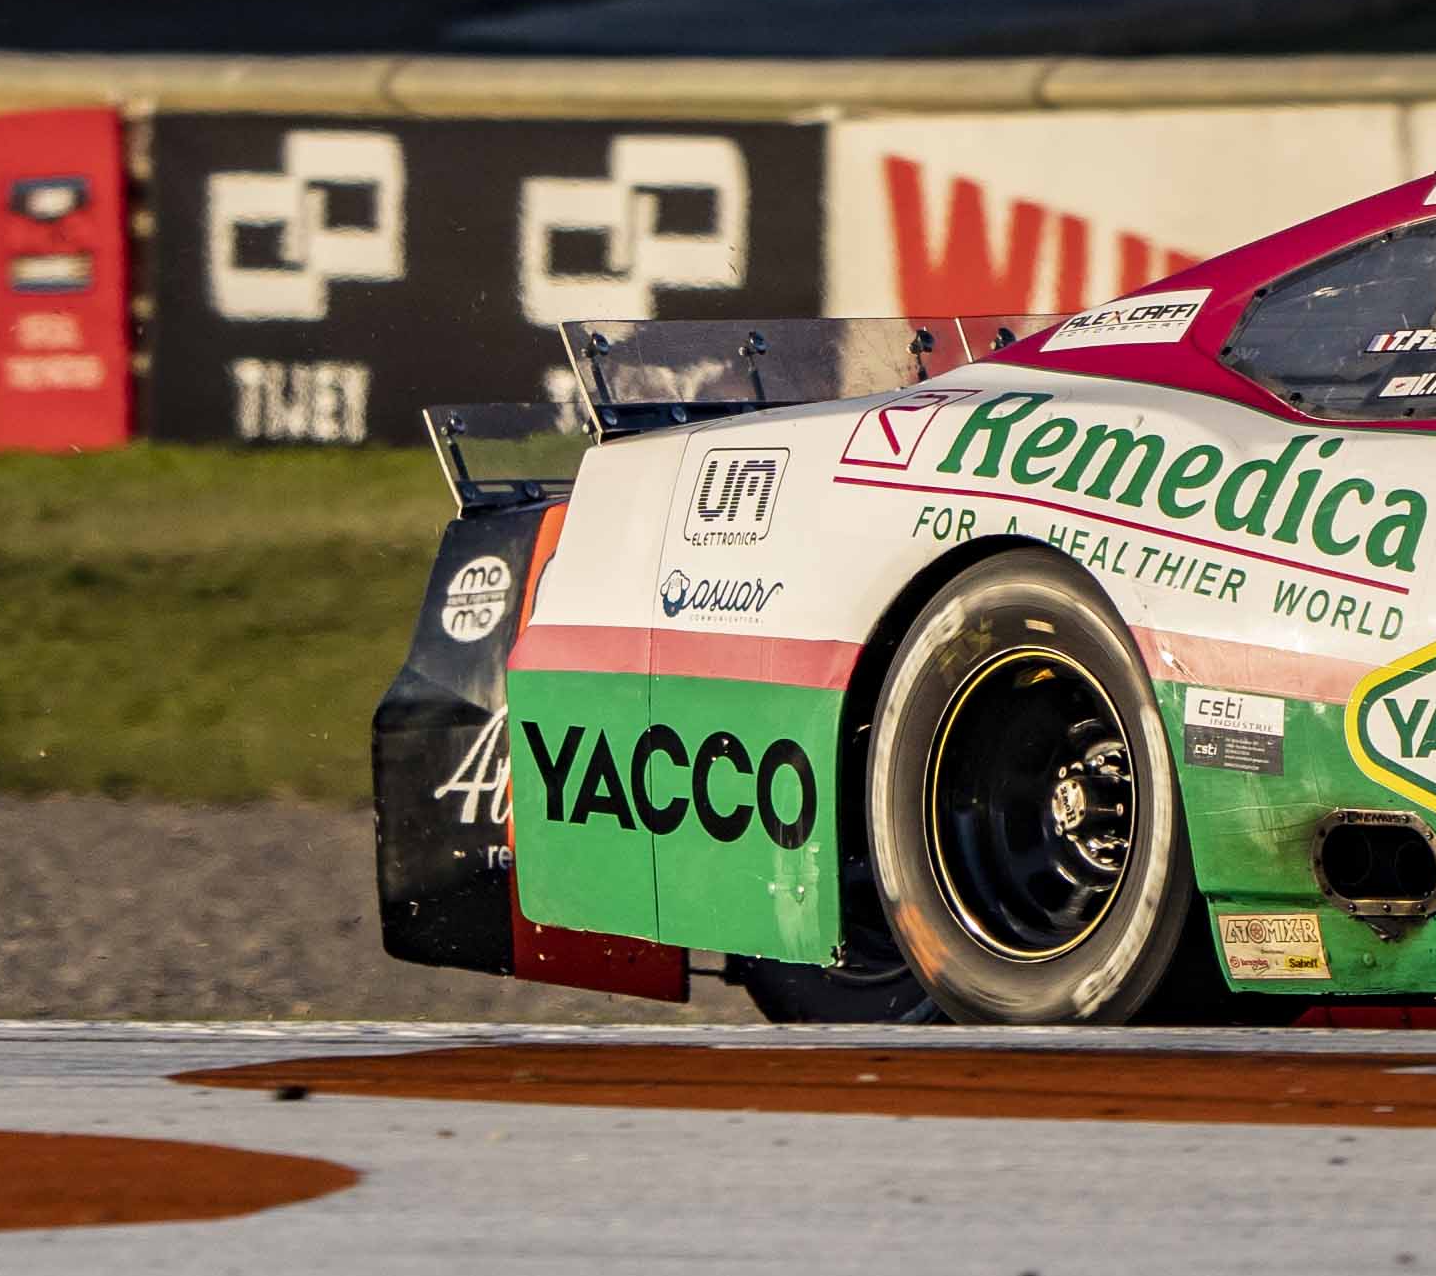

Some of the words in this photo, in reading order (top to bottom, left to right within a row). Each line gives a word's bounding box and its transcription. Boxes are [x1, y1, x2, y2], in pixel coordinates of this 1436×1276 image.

[1064, 309, 1129, 330] ALEX
[1128, 303, 1199, 321] CAFFI
[937, 391, 1428, 573] Remedica
[691, 531, 758, 546] ELETTRONICA
[912, 506, 977, 541] FOR
[1048, 522, 1247, 603] HEALTHIER
[1273, 579, 1404, 641] WORLD
[520, 720, 817, 852] YACCO
[1225, 918, 1320, 944] ATOMIX-R
